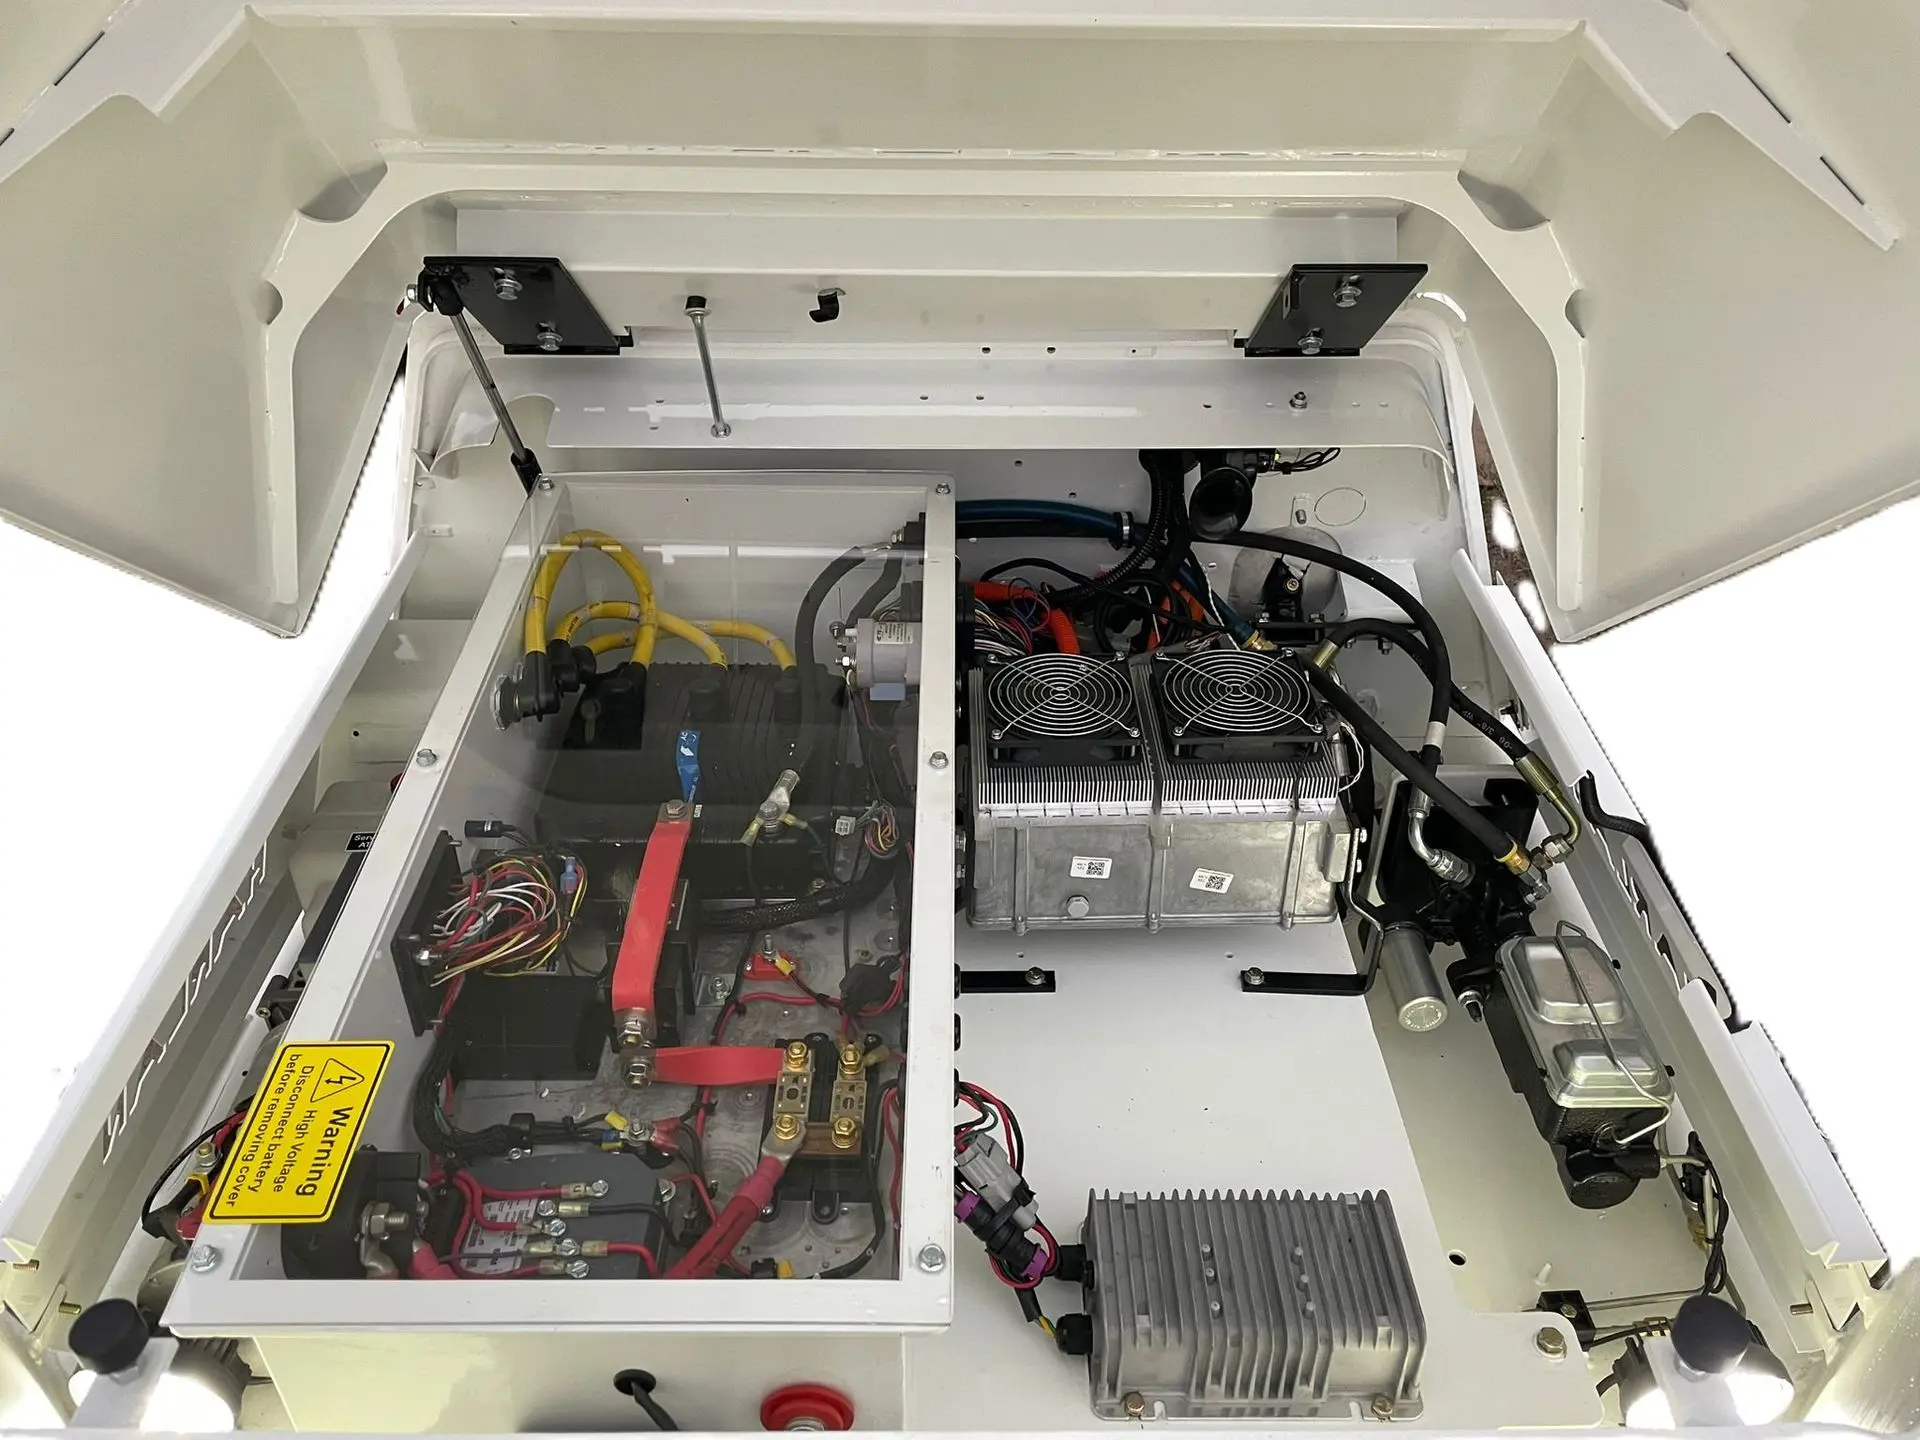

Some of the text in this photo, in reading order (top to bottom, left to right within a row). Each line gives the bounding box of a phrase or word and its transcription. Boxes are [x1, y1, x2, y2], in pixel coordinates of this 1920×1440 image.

[225, 1054, 302, 1207] before removing cover
[247, 1065, 315, 1193] Disconnect battery
[273, 1110, 318, 1192] High Voltage
[295, 1106, 354, 1196] Warning
